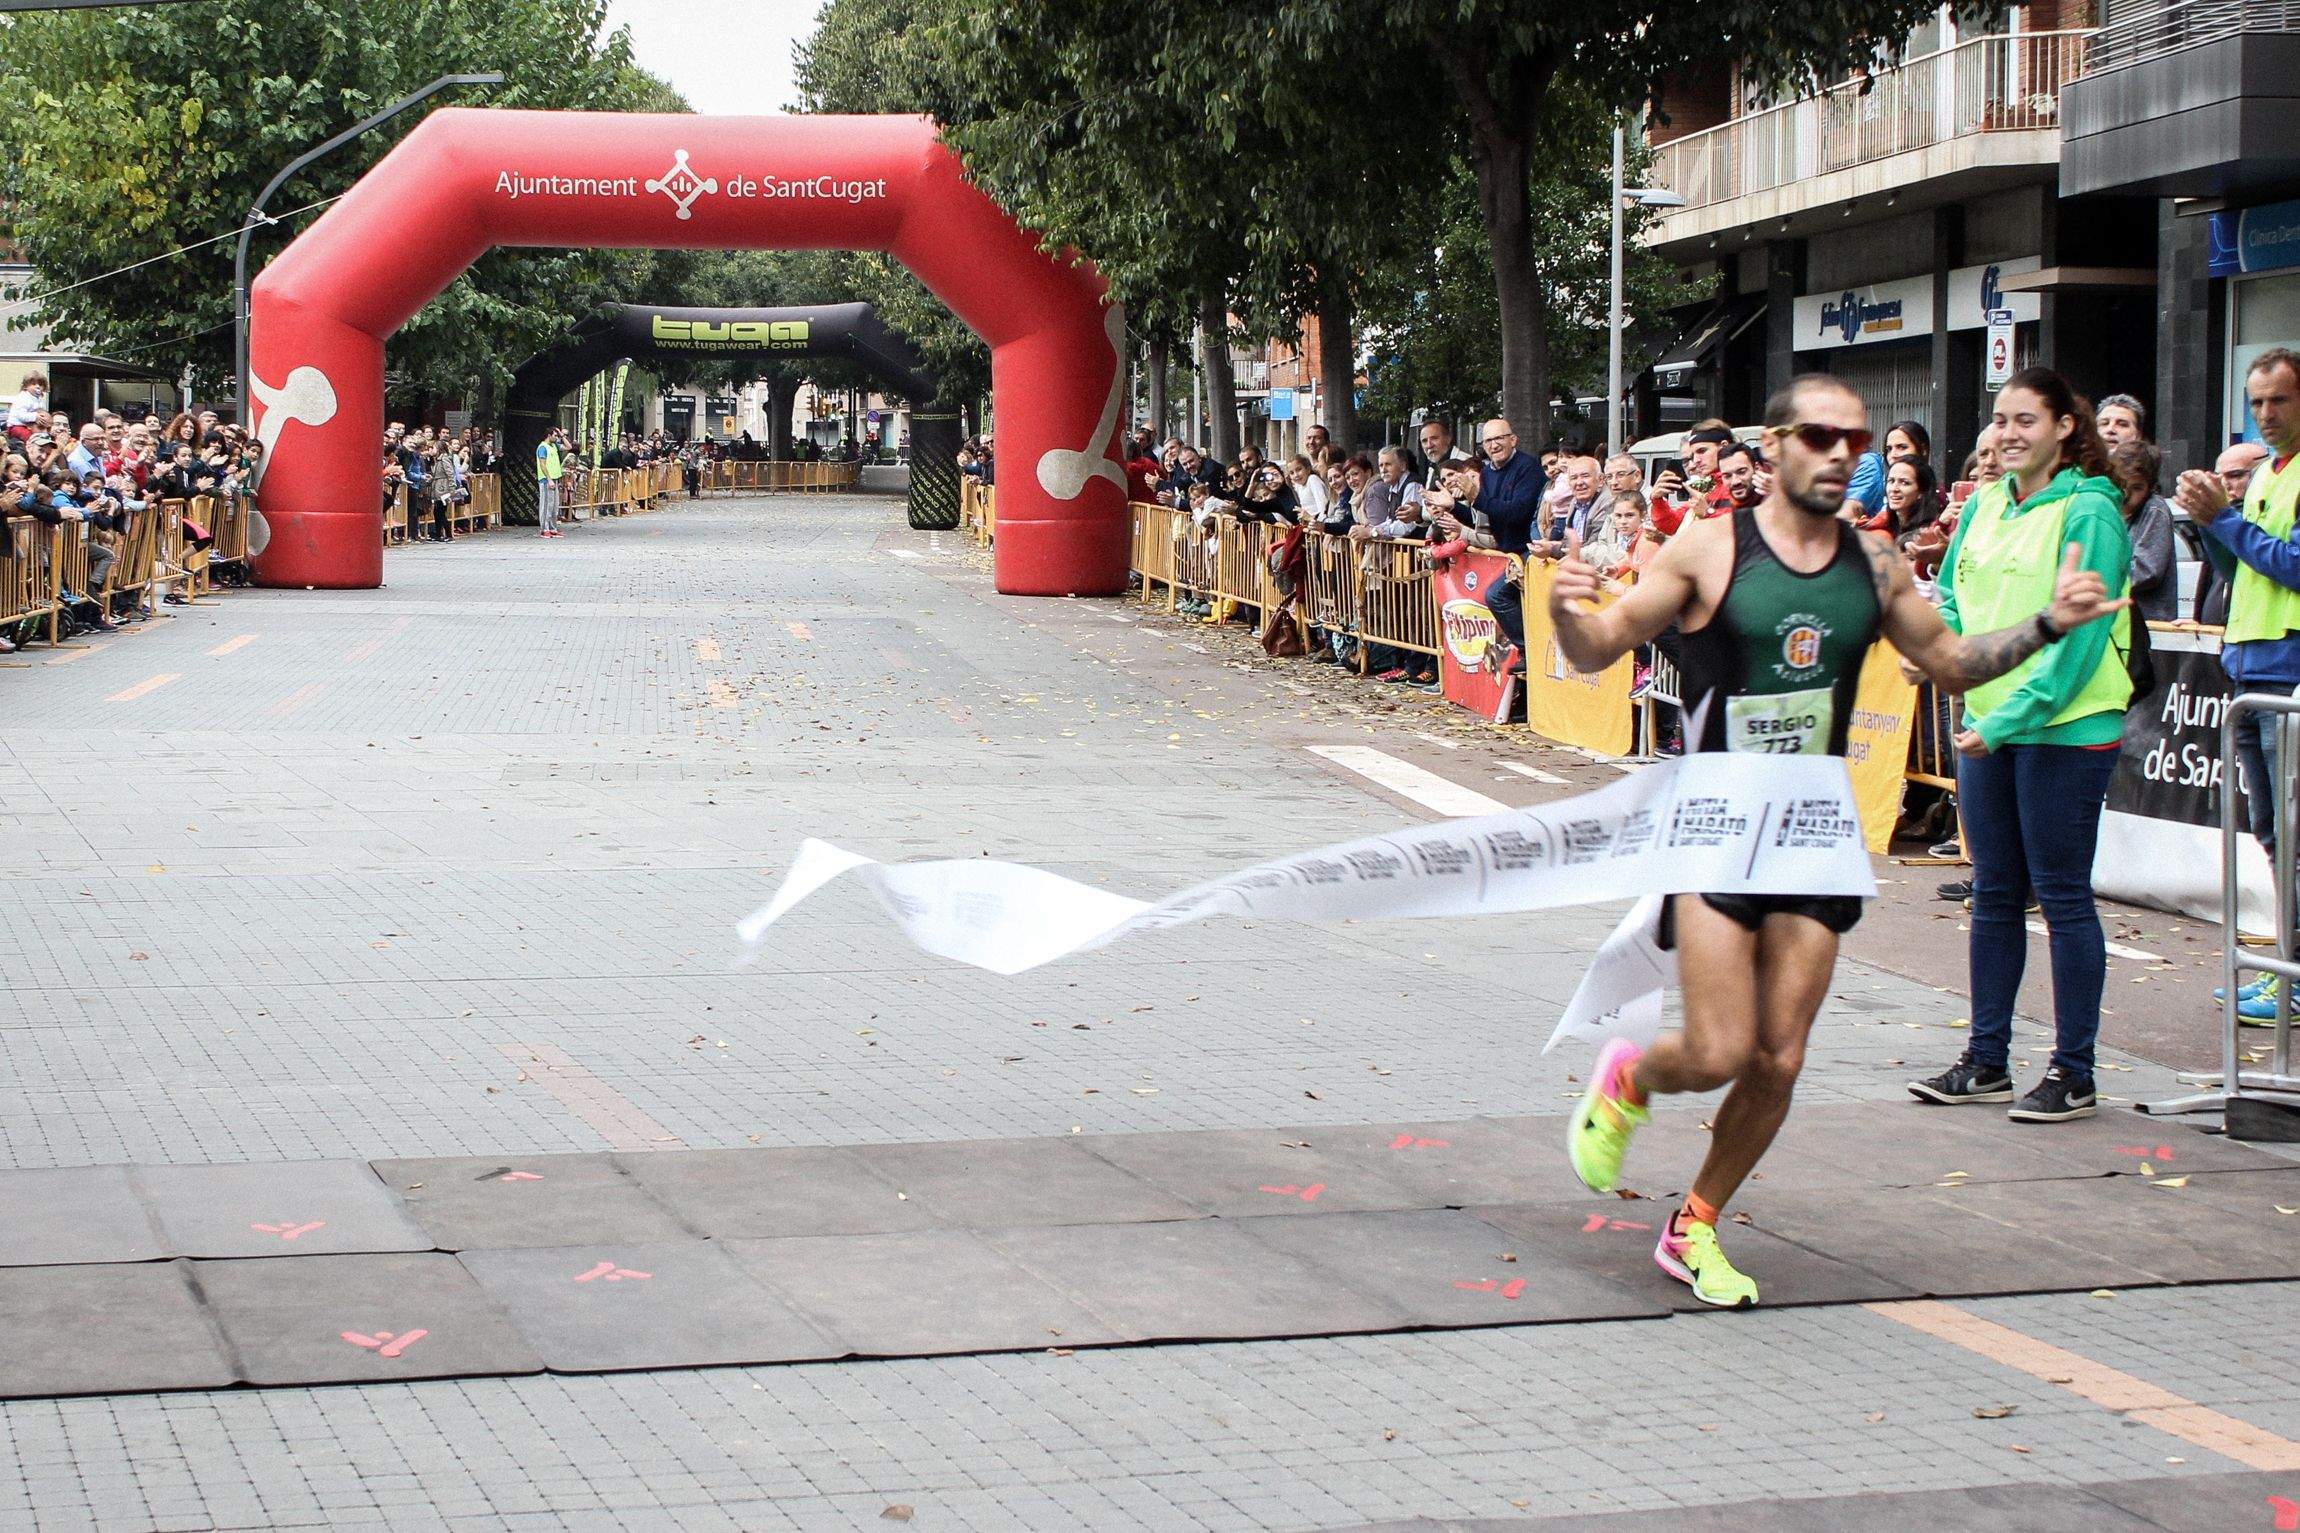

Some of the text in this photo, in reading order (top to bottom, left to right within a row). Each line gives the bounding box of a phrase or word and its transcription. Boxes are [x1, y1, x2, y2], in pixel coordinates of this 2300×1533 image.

[495, 171, 886, 204] Ajuntament de SantCugat
[653, 315, 809, 346] tuga
[655, 339, 808, 351] www.tugawear.com
[1748, 715, 1816, 734] SERGIO
[1763, 736, 1802, 753] 773
[2143, 738, 2177, 783] de
